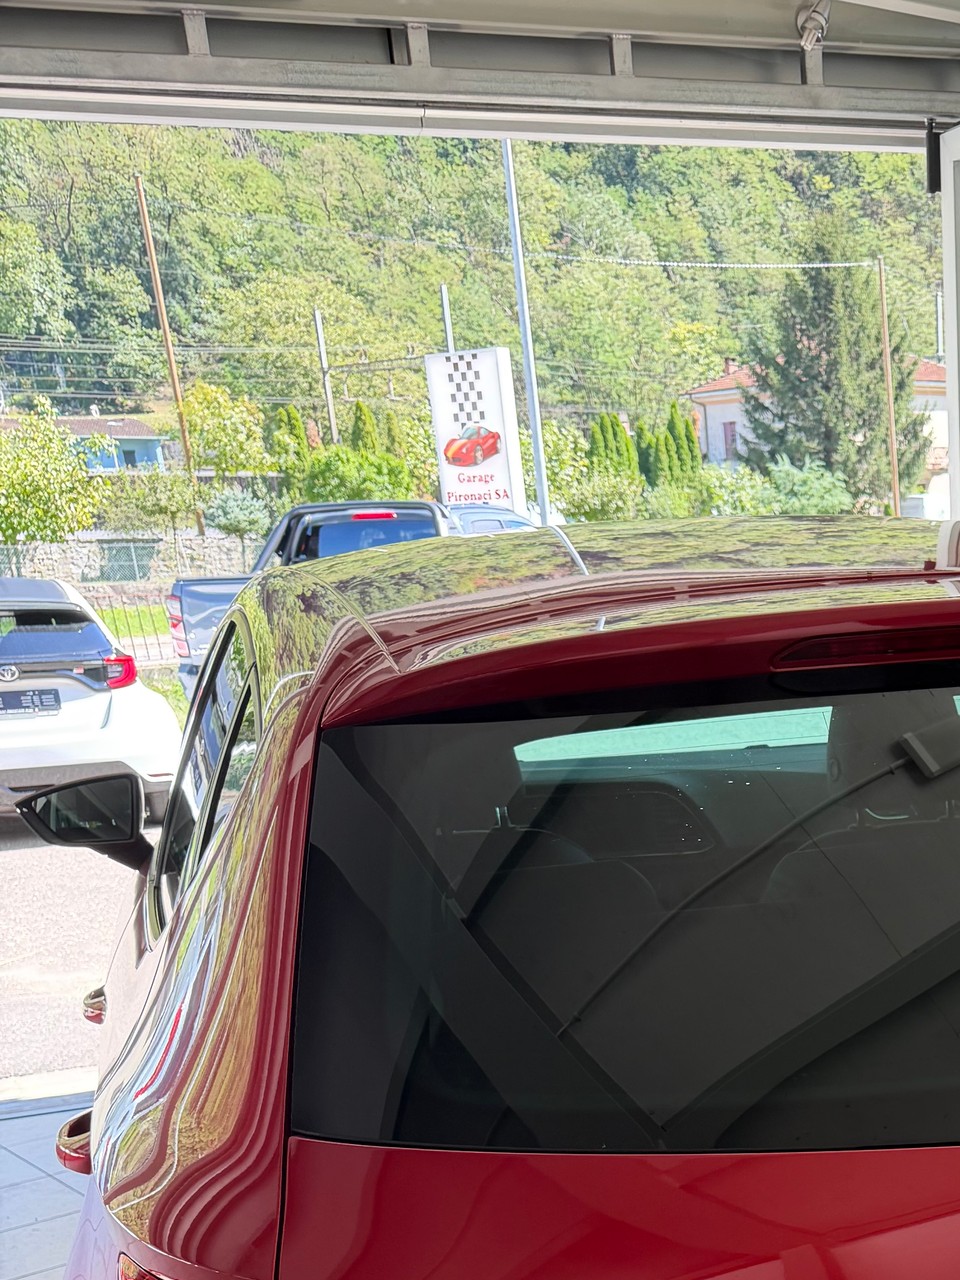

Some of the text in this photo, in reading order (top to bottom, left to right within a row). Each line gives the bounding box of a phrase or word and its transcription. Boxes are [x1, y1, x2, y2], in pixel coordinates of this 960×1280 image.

[457, 472, 495, 484] Garage
[447, 488, 510, 502] Pironaci SA
